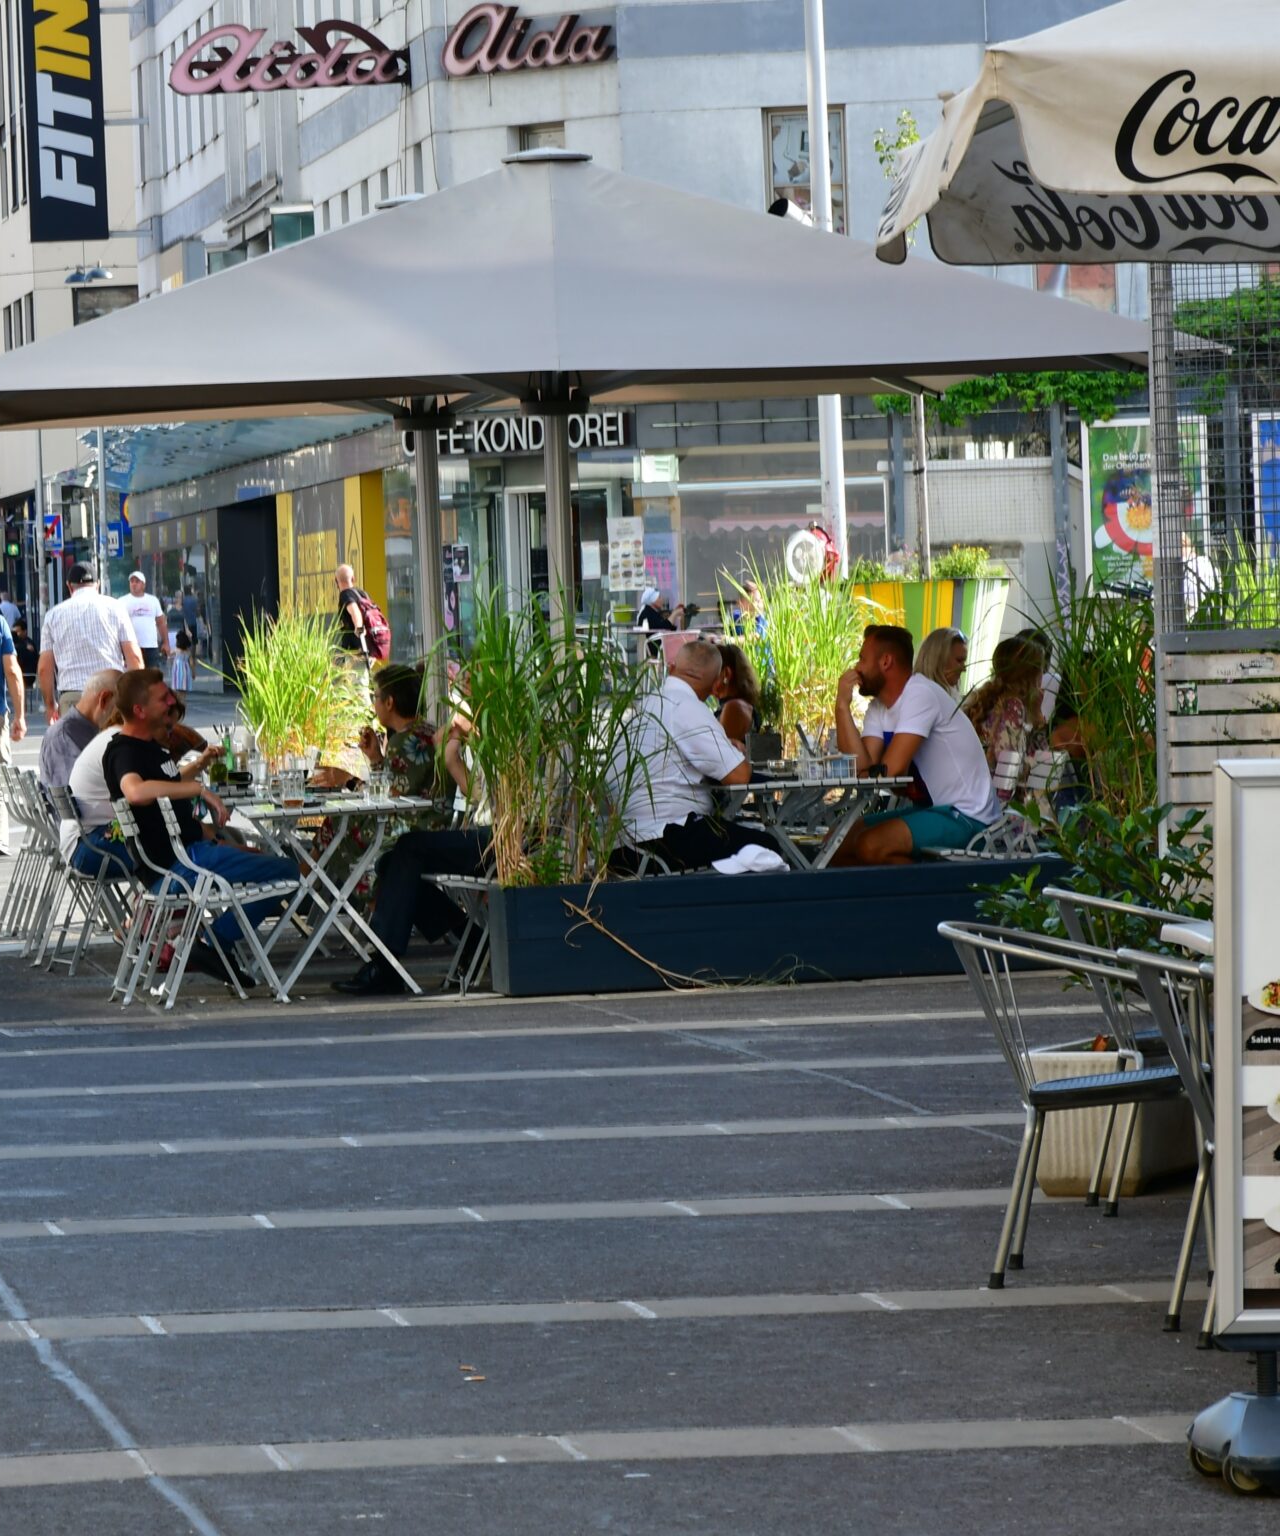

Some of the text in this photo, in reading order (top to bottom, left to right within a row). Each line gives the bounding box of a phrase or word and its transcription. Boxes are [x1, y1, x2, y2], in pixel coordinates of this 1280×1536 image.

[169, 23, 400, 95] Aida
[440, 2, 617, 77] Aida
[1251, 1035, 1272, 1044] Salat
